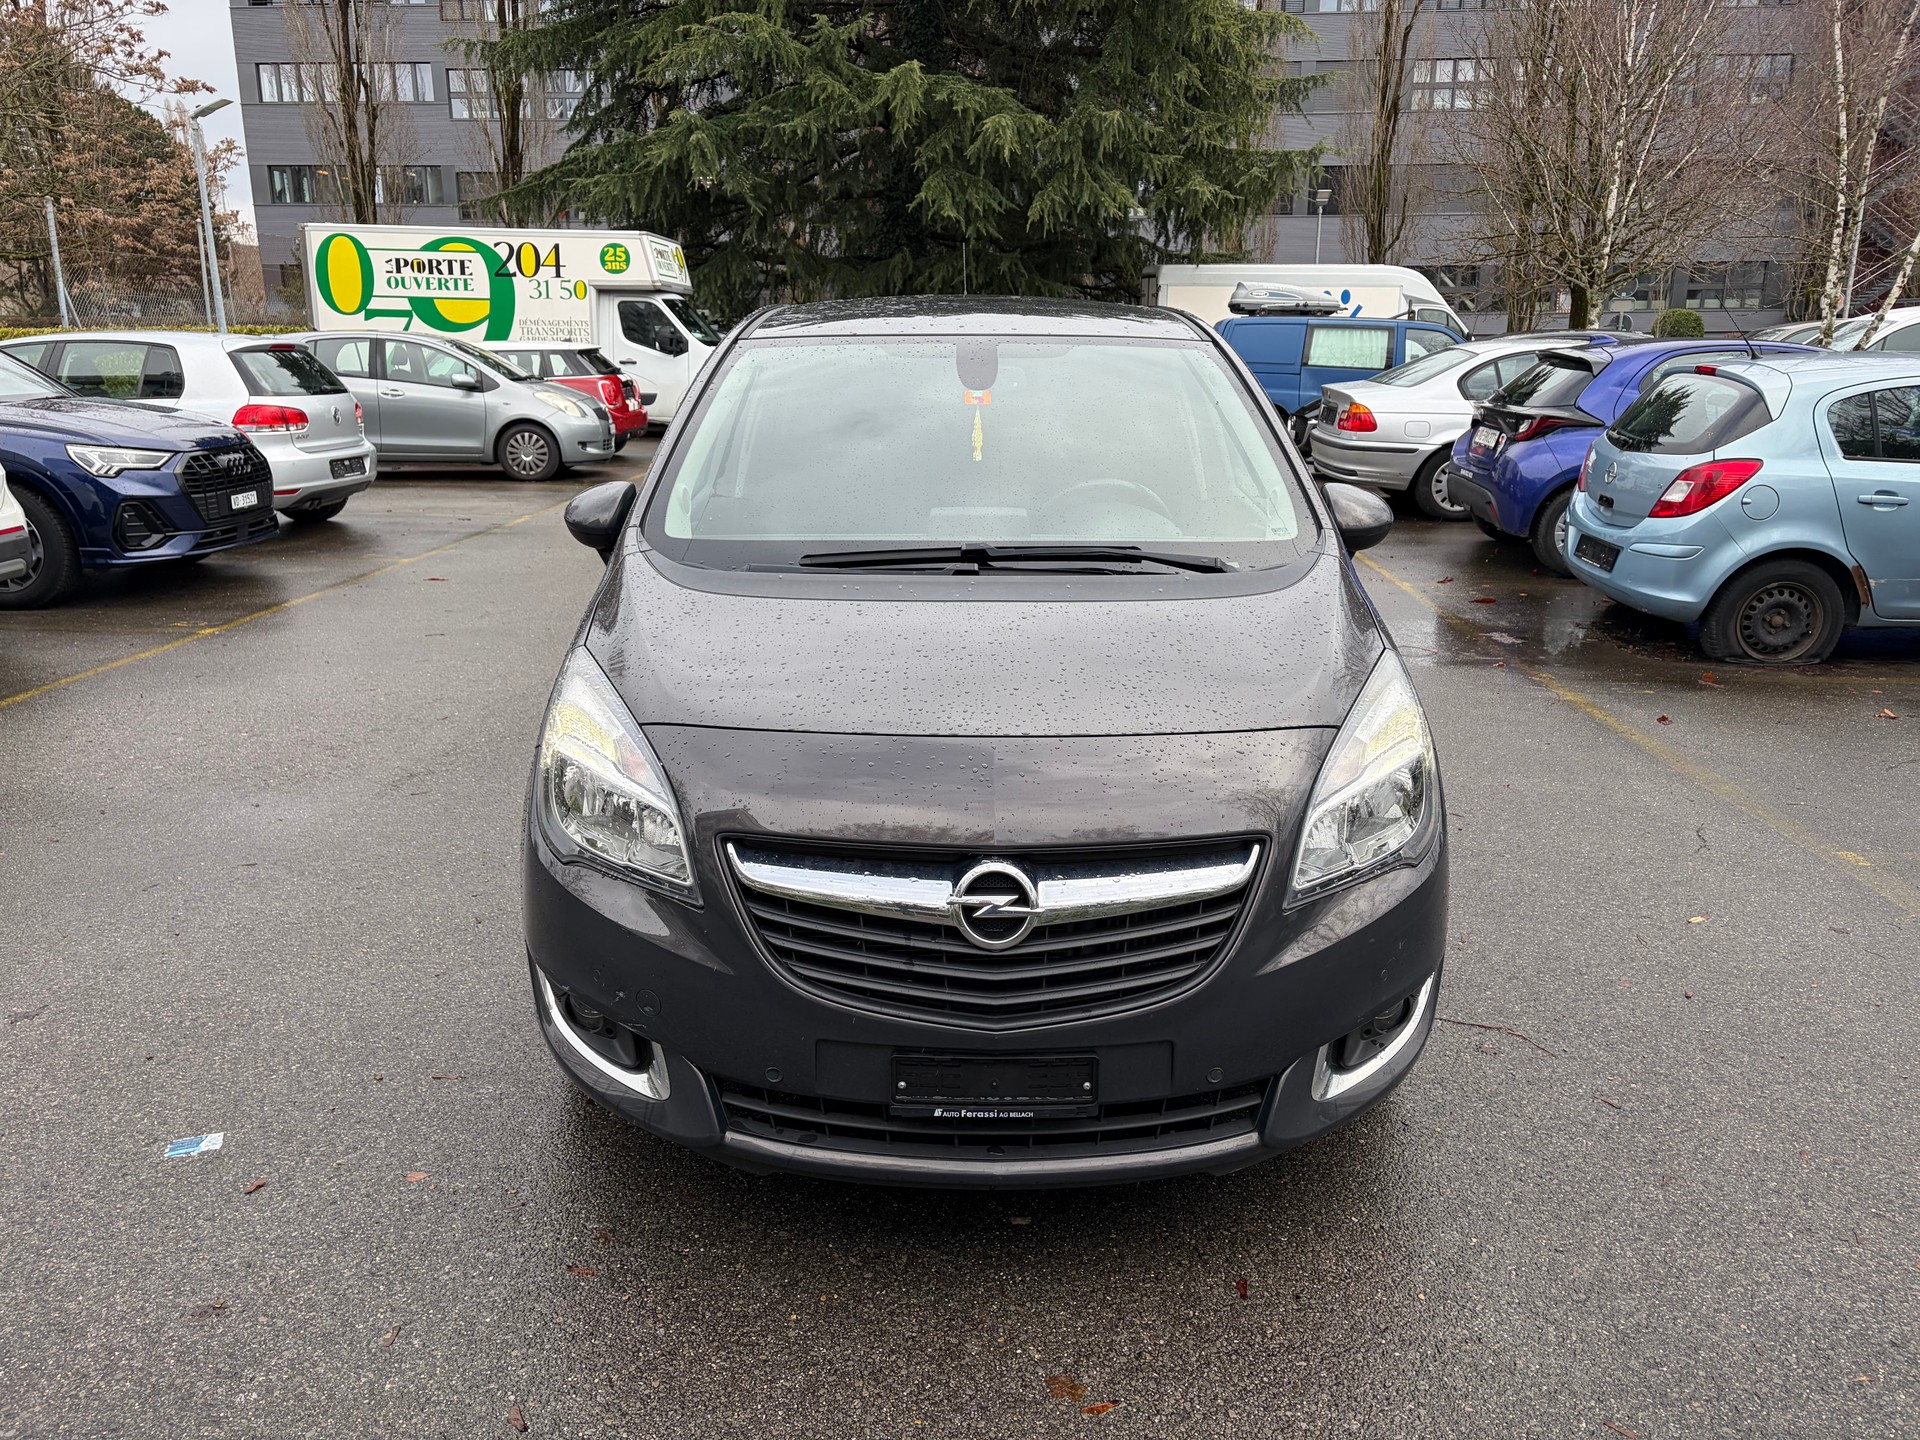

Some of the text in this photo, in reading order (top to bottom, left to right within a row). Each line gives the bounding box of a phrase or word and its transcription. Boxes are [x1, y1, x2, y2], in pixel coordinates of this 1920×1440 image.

[493, 241, 566, 278] 204
[603, 246, 627, 261] 25
[385, 258, 394, 274] LA
[394, 257, 473, 276] PORTE
[604, 261, 627, 270] ans
[386, 275, 475, 292] OUVERTE
[528, 278, 588, 301] 31 50
[519, 317, 590, 327] DÉMÉNAGEMENTS
[520, 326, 590, 337] TRANSPORTS
[961, 1109, 998, 1118] Ferassi
